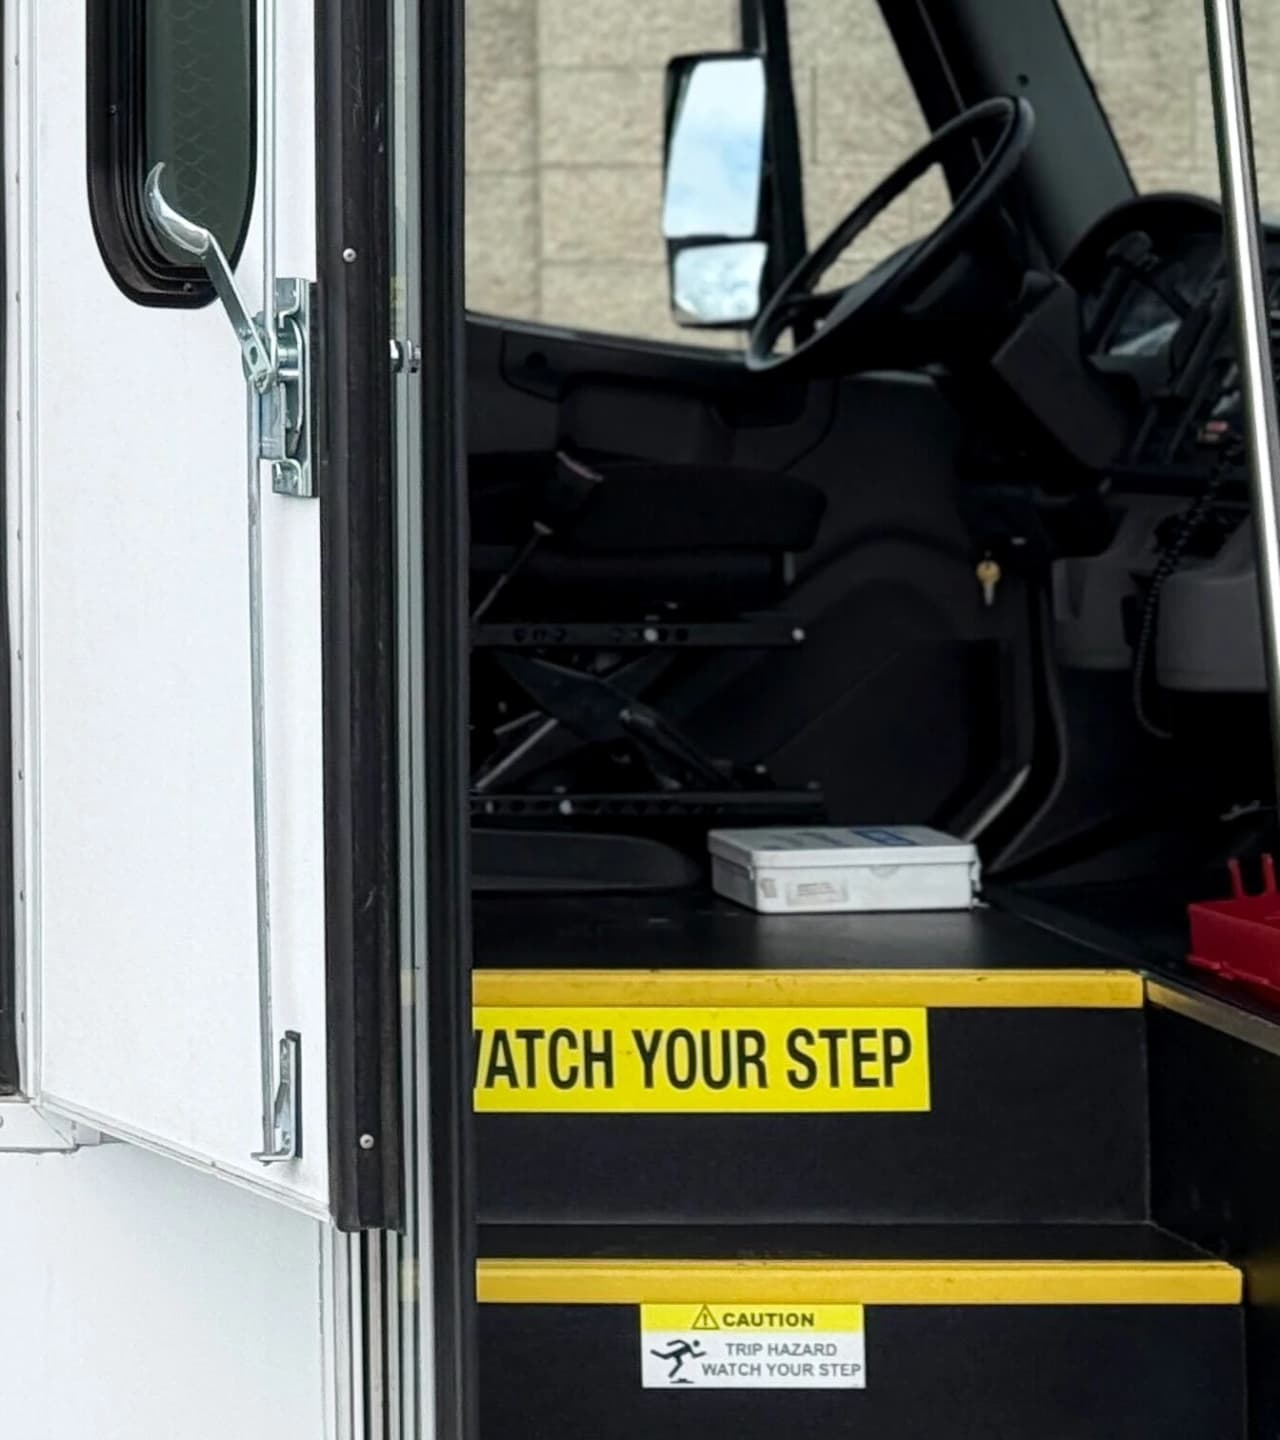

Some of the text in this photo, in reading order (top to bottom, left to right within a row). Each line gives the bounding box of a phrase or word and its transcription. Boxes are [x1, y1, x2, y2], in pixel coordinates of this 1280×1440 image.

[631, 1028, 769, 1089] YOUR
[786, 1028, 912, 1089] STEP
[722, 1312, 815, 1327] CAUTION
[726, 1343, 838, 1356] TRIP HAZARD
[701, 1363, 861, 1376] WATCH YOUR STEP
